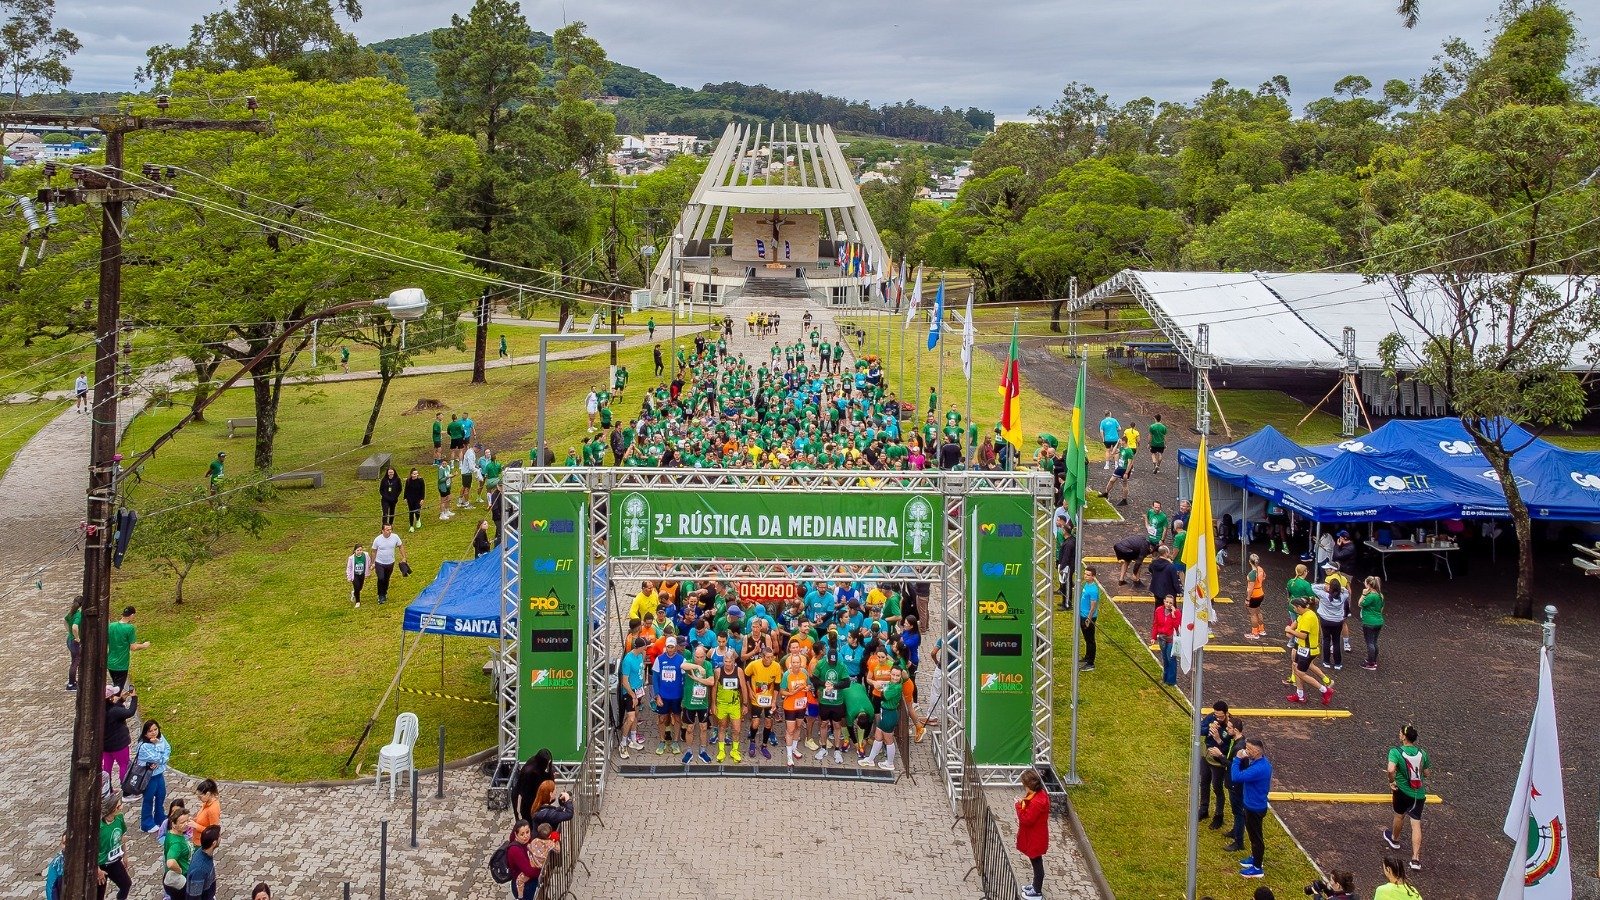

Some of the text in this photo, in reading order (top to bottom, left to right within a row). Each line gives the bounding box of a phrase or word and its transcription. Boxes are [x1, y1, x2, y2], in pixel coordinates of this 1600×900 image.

[1213, 448, 1255, 468] GOFIT
[1263, 456, 1320, 472] GOFIT
[1288, 471, 1334, 494] GOFIT
[1368, 475, 1429, 491] GOFIT
[654, 510, 899, 538] 3ª RÚSTICA DA MEDIANEIRA
[740, 583, 794, 598] 00:00:00
[530, 597, 559, 610] PRO
[978, 601, 1007, 614] PRO
[454, 618, 498, 634] SANTA
[548, 668, 574, 679] ÍTALO
[998, 672, 1023, 683] ÍTALO
